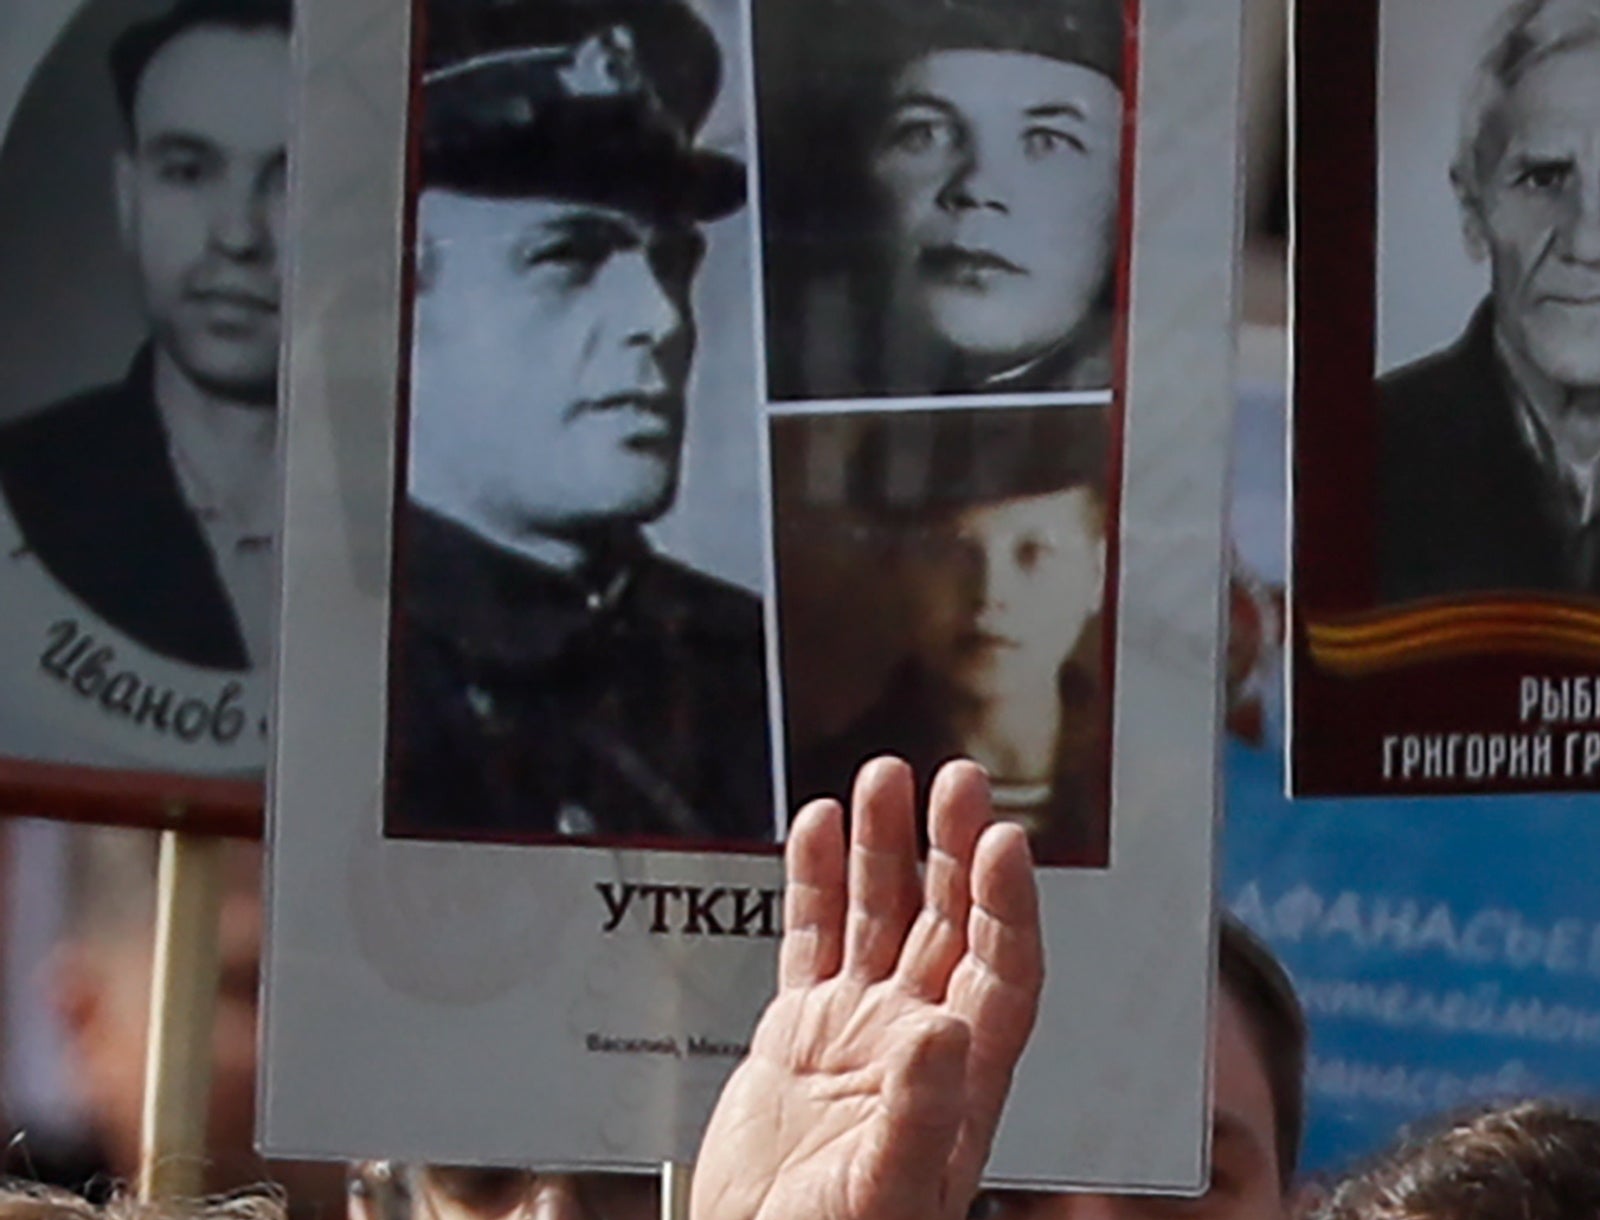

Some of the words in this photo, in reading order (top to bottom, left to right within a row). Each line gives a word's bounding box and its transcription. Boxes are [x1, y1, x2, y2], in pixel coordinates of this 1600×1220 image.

[38, 617, 246, 744] Иванов
[1382, 727, 1551, 779] ГРИГОРИЙ
[596, 882, 785, 937] УТКИ
